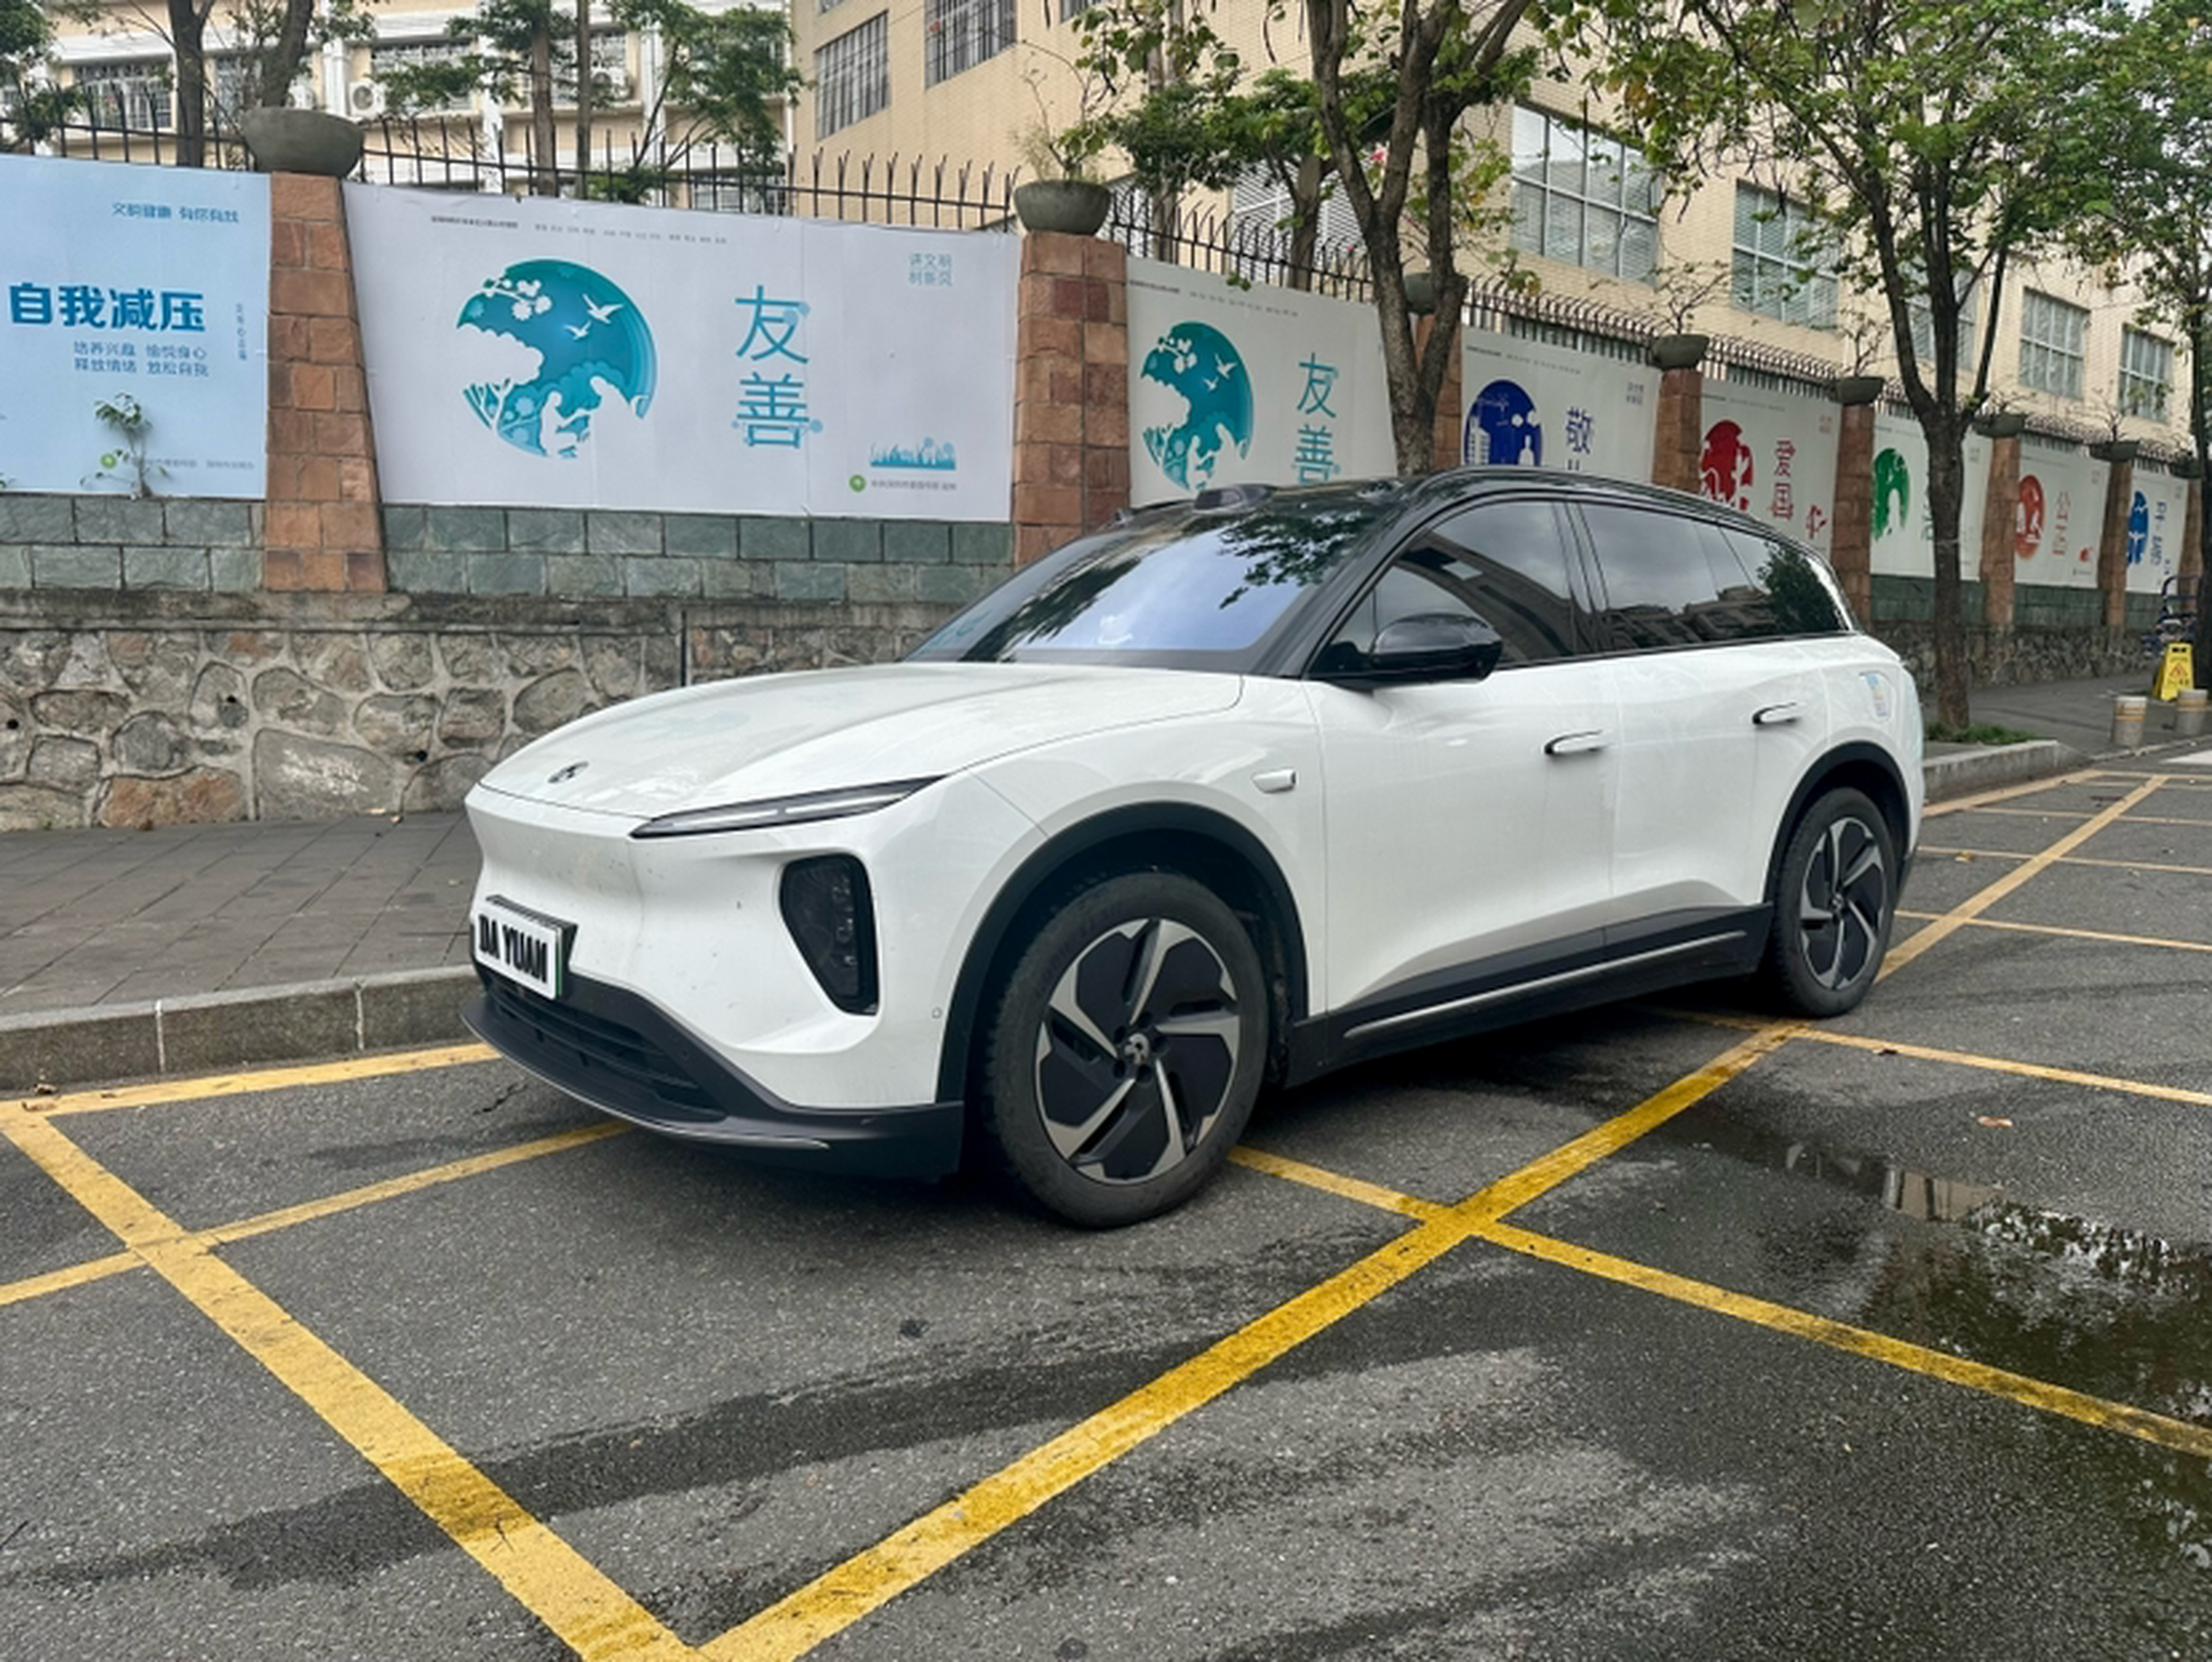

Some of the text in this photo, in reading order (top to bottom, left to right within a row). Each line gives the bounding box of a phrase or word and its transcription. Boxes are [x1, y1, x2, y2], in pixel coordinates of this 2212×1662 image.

[9, 283, 206, 332] 自我减压
[734, 284, 811, 450] 友善
[1294, 351, 1338, 486] 友善
[1772, 439, 1796, 520] 爱国
[479, 913, 547, 983] DA YUAN
